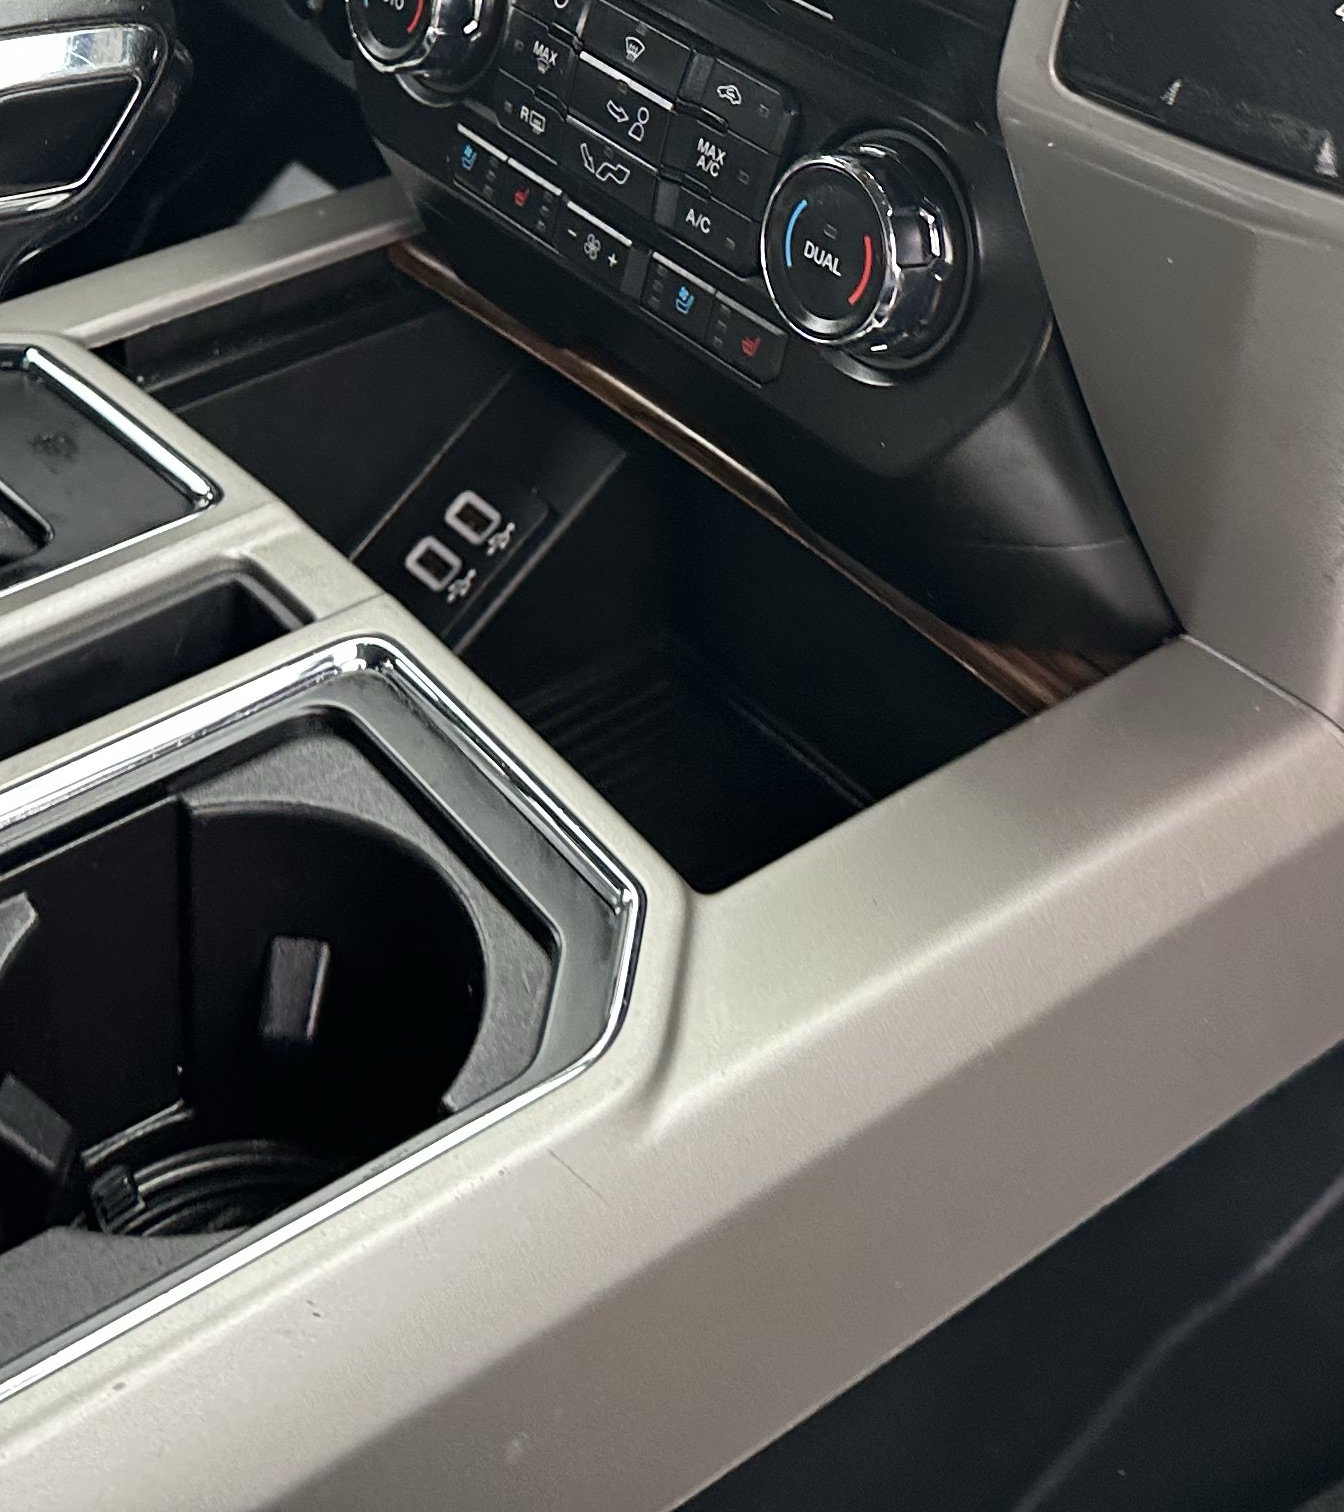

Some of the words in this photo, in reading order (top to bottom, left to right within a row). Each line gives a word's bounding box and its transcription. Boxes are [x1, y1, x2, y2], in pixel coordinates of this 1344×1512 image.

[533, 40, 558, 66] MAX
[697, 138, 726, 166] MAX
[696, 155, 722, 177] A/C
[685, 208, 711, 234] A/C
[803, 237, 842, 278] DUAL
